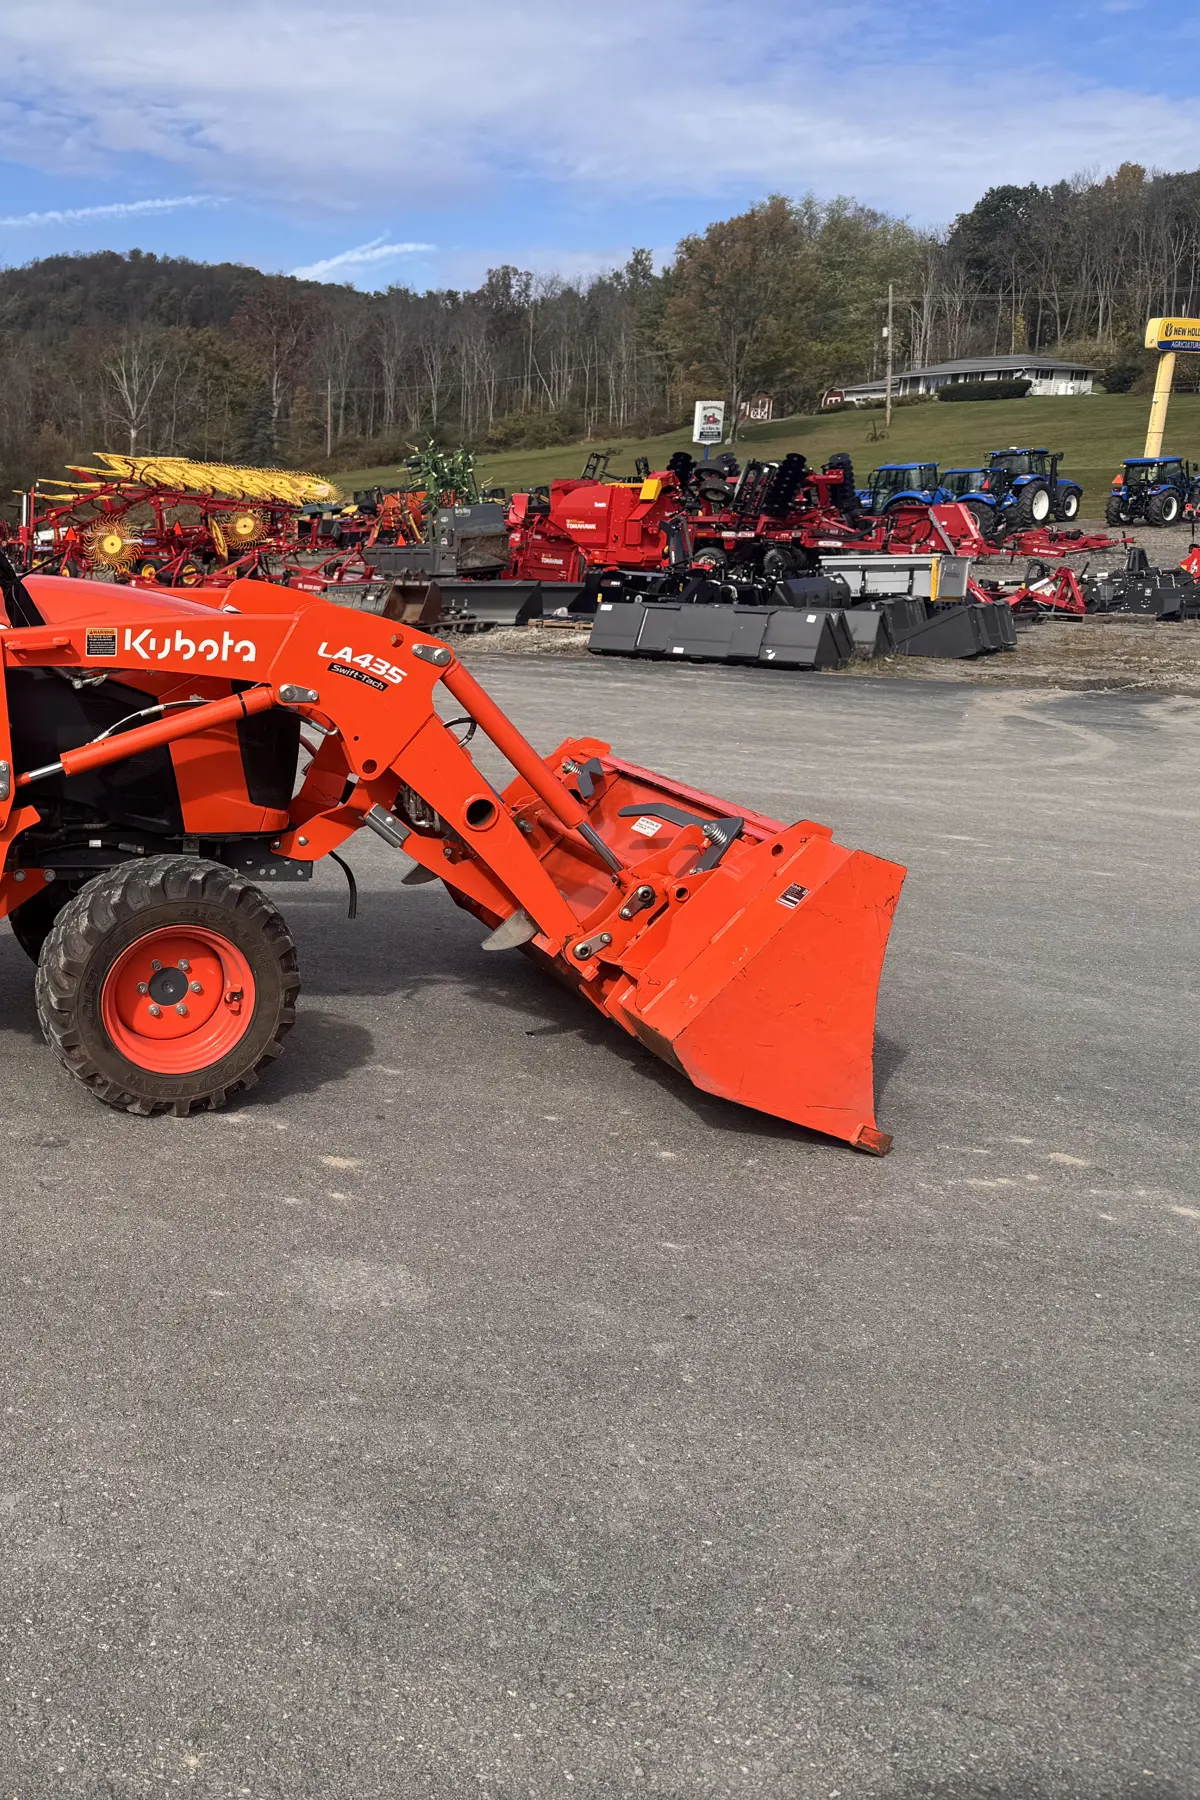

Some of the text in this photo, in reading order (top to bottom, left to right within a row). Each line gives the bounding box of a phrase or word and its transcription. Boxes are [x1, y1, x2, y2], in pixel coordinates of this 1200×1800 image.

[1174, 327, 1186, 335] NEW
[124, 628, 256, 662] Kubota
[317, 641, 408, 684] LA435
[331, 664, 384, 690] Swift-Tach
